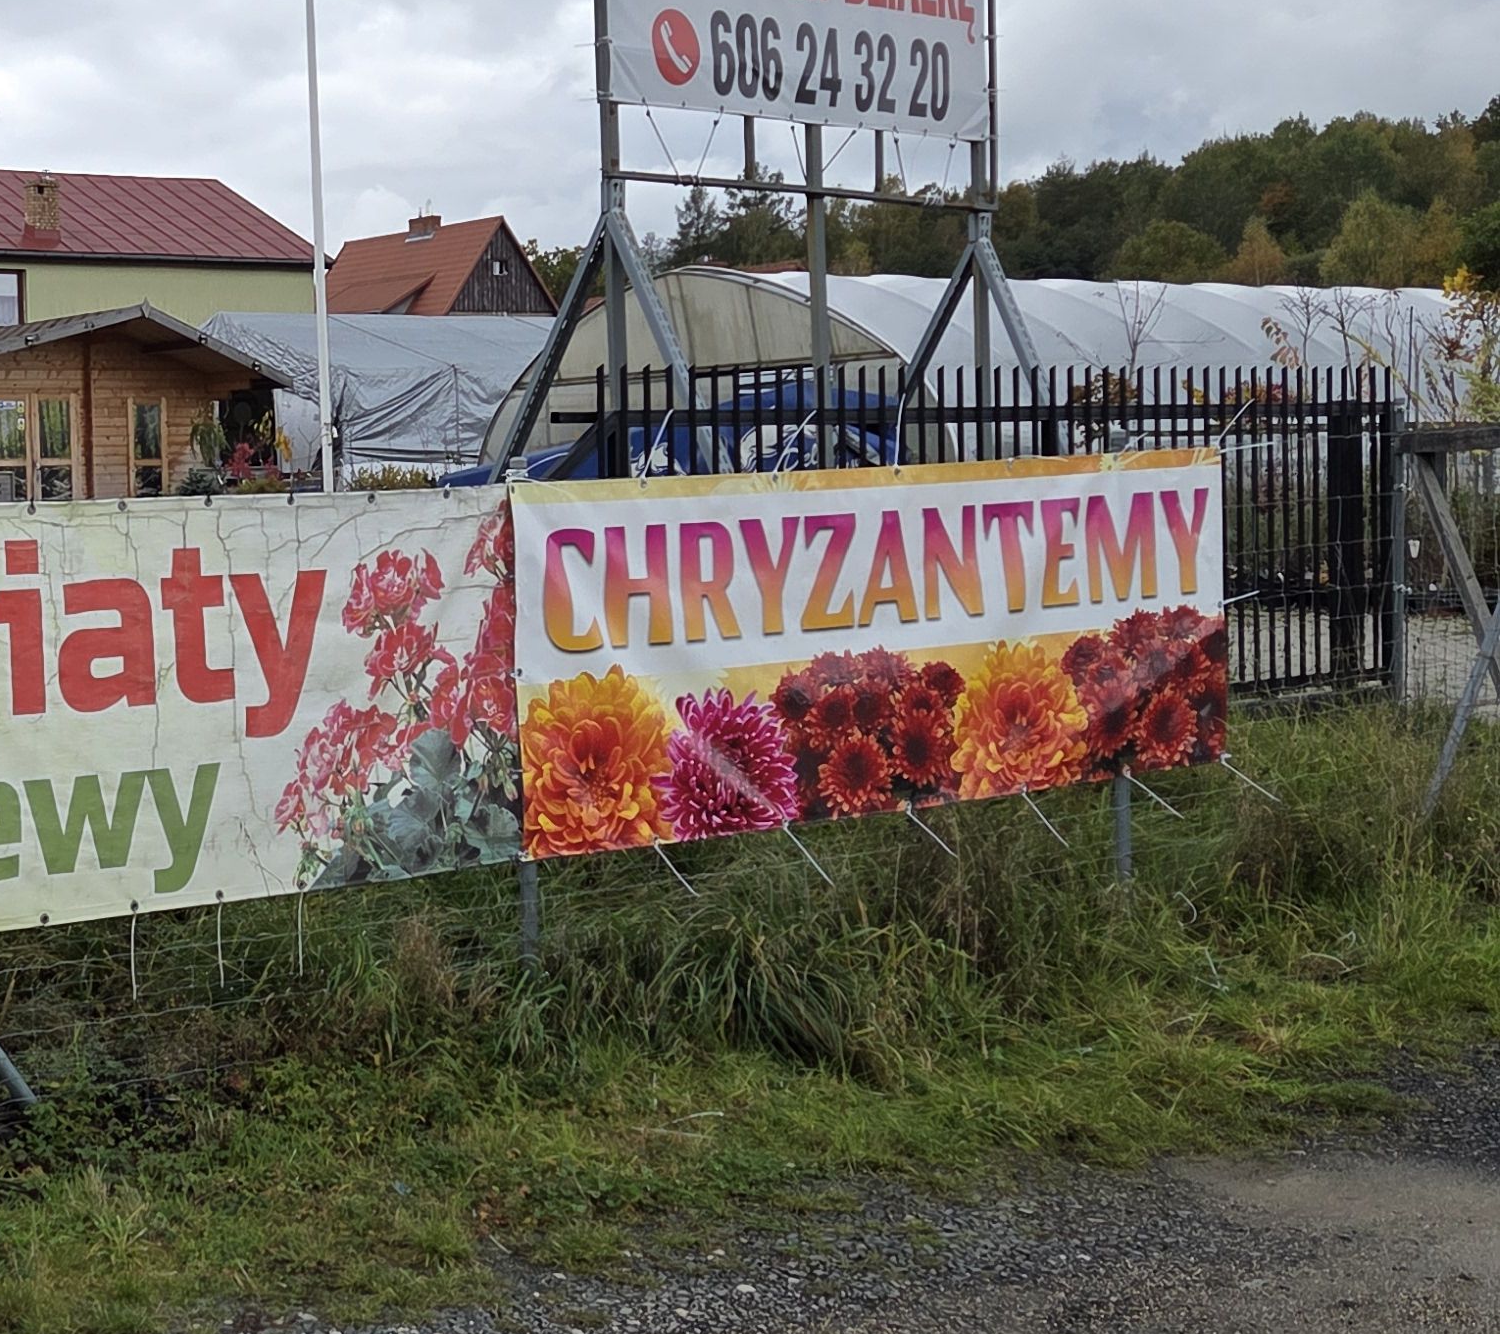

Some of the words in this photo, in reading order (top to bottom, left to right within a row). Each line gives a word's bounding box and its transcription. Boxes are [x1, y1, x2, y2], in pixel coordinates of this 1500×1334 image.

[710, 9, 784, 101] 606
[794, 21, 842, 107] 24
[853, 30, 897, 113] 32
[908, 38, 951, 122] 20
[543, 487, 1210, 653] CHRYZANTEMY
